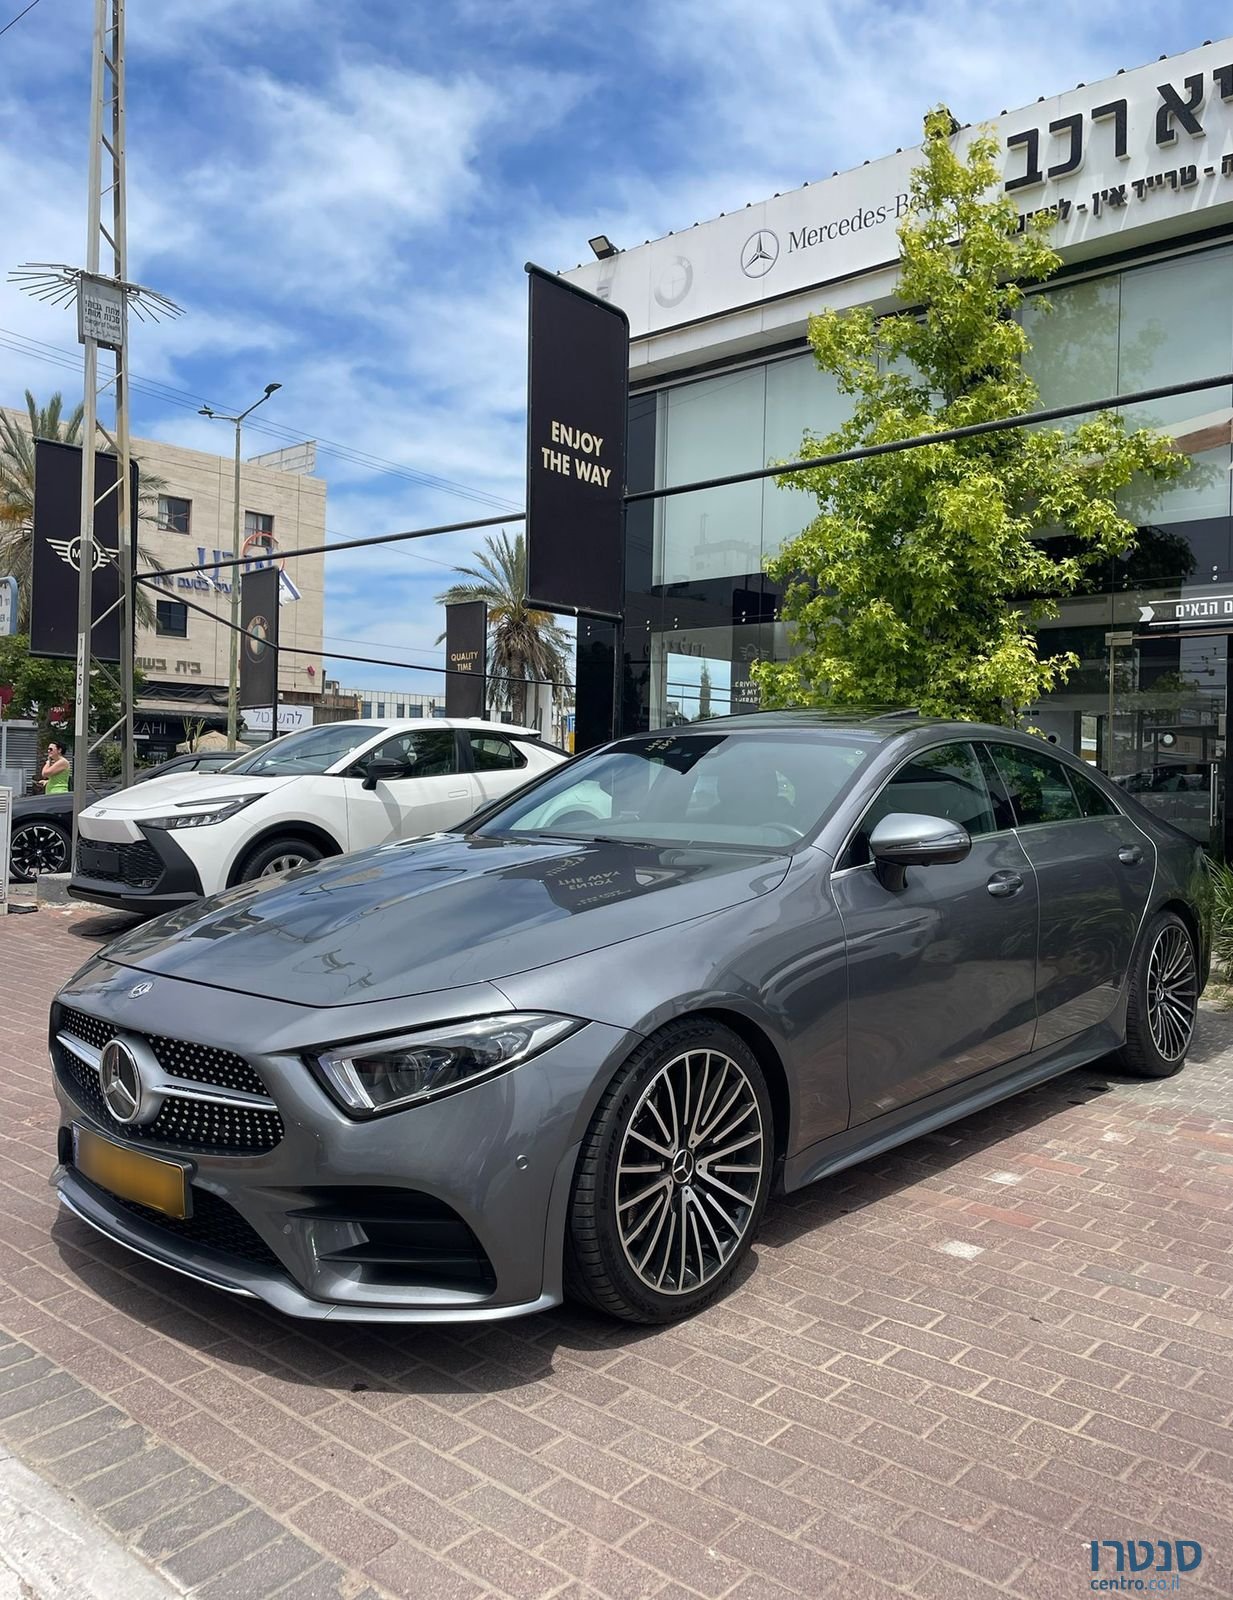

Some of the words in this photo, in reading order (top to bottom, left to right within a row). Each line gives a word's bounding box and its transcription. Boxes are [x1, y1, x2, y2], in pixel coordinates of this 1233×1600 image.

[1004, 98, 1127, 192] רכב
[1131, 164, 1197, 199] טרייד
[1092, 184, 1126, 217] אין
[788, 193, 930, 253] Mercedes-Be
[552, 421, 603, 457] ENJOY
[542, 447, 570, 476] THE
[575, 458, 612, 488] WAY
[1175, 601, 1219, 618] הבאים
[175, 660, 201, 675] בית
[451, 651, 479, 661] QUALITY
[457, 662, 472, 672] TIME
